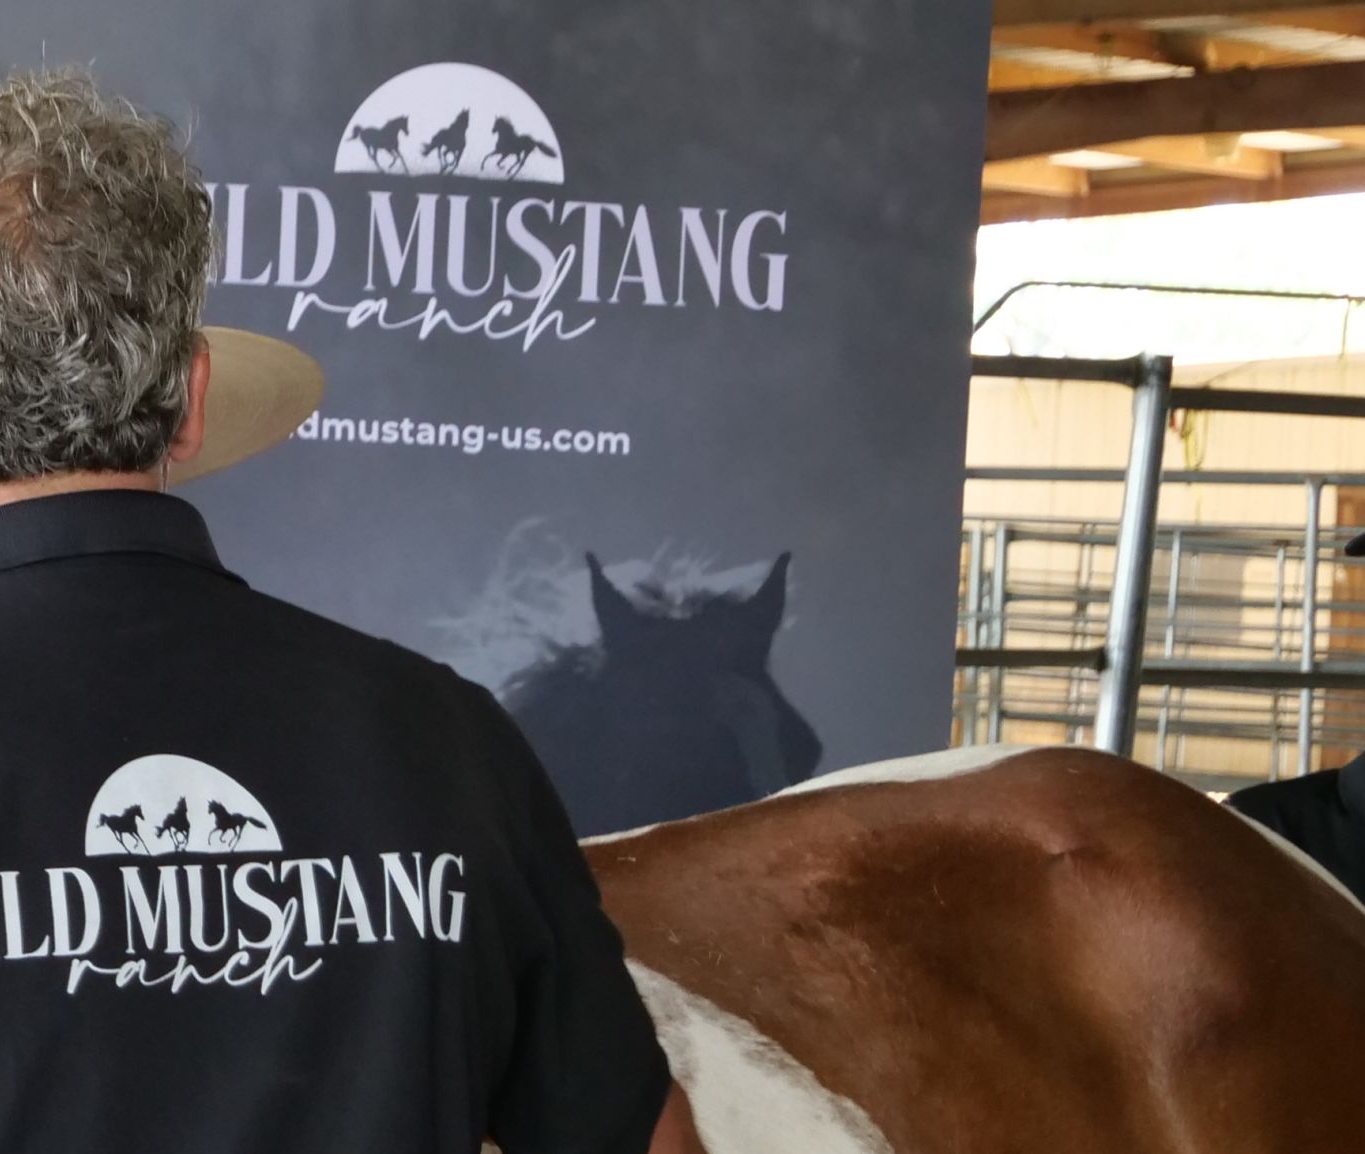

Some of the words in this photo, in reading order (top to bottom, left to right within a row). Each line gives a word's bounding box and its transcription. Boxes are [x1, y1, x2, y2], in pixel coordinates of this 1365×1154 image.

[204, 182, 336, 287] LD
[363, 192, 787, 312] MUSTANG
[287, 244, 597, 353] ranch
[289, 410, 630, 455] dmustang-us.com
[66, 896, 323, 995] ranch
[118, 852, 466, 954] MUSTANG
